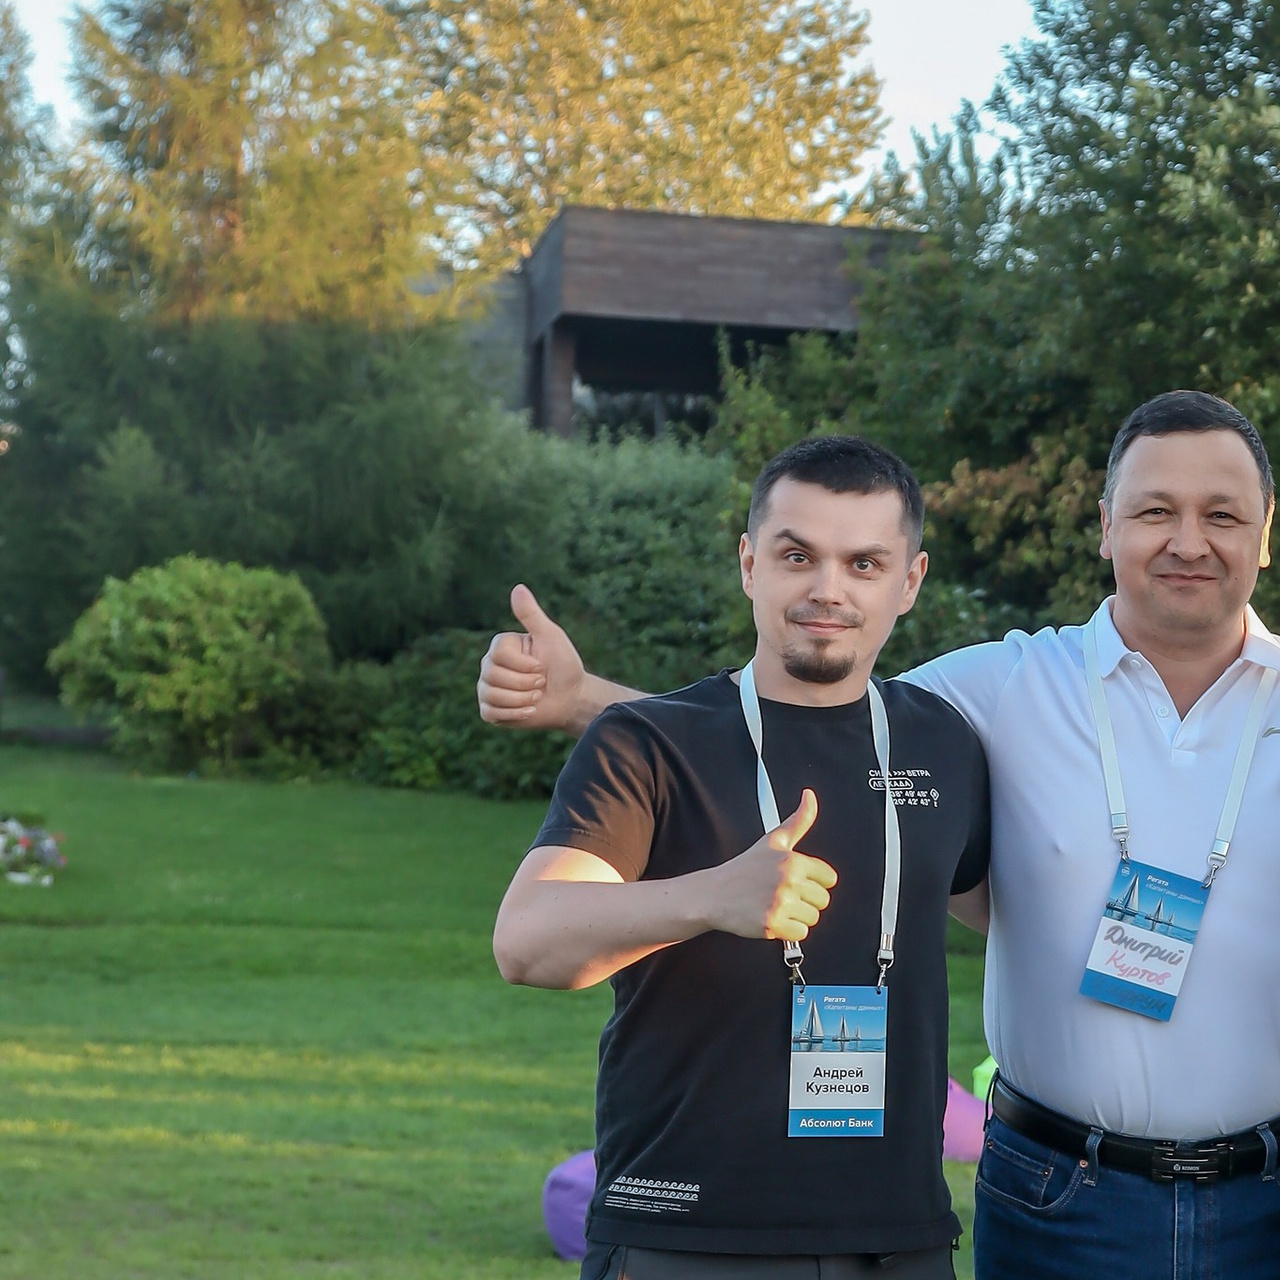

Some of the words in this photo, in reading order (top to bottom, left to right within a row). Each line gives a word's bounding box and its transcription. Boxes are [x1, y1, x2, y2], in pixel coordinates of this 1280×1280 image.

[868, 769, 893, 777] СИА
[906, 769, 931, 777] ВЕТРА
[1146, 875, 1169, 887] Регата
[1104, 925, 1185, 966] Дмитрий
[813, 1066, 863, 1080] Андрей
[806, 1081, 869, 1096] Кузнецов
[800, 1118, 846, 1128] Абсолют
[848, 1118, 874, 1128] Банк
